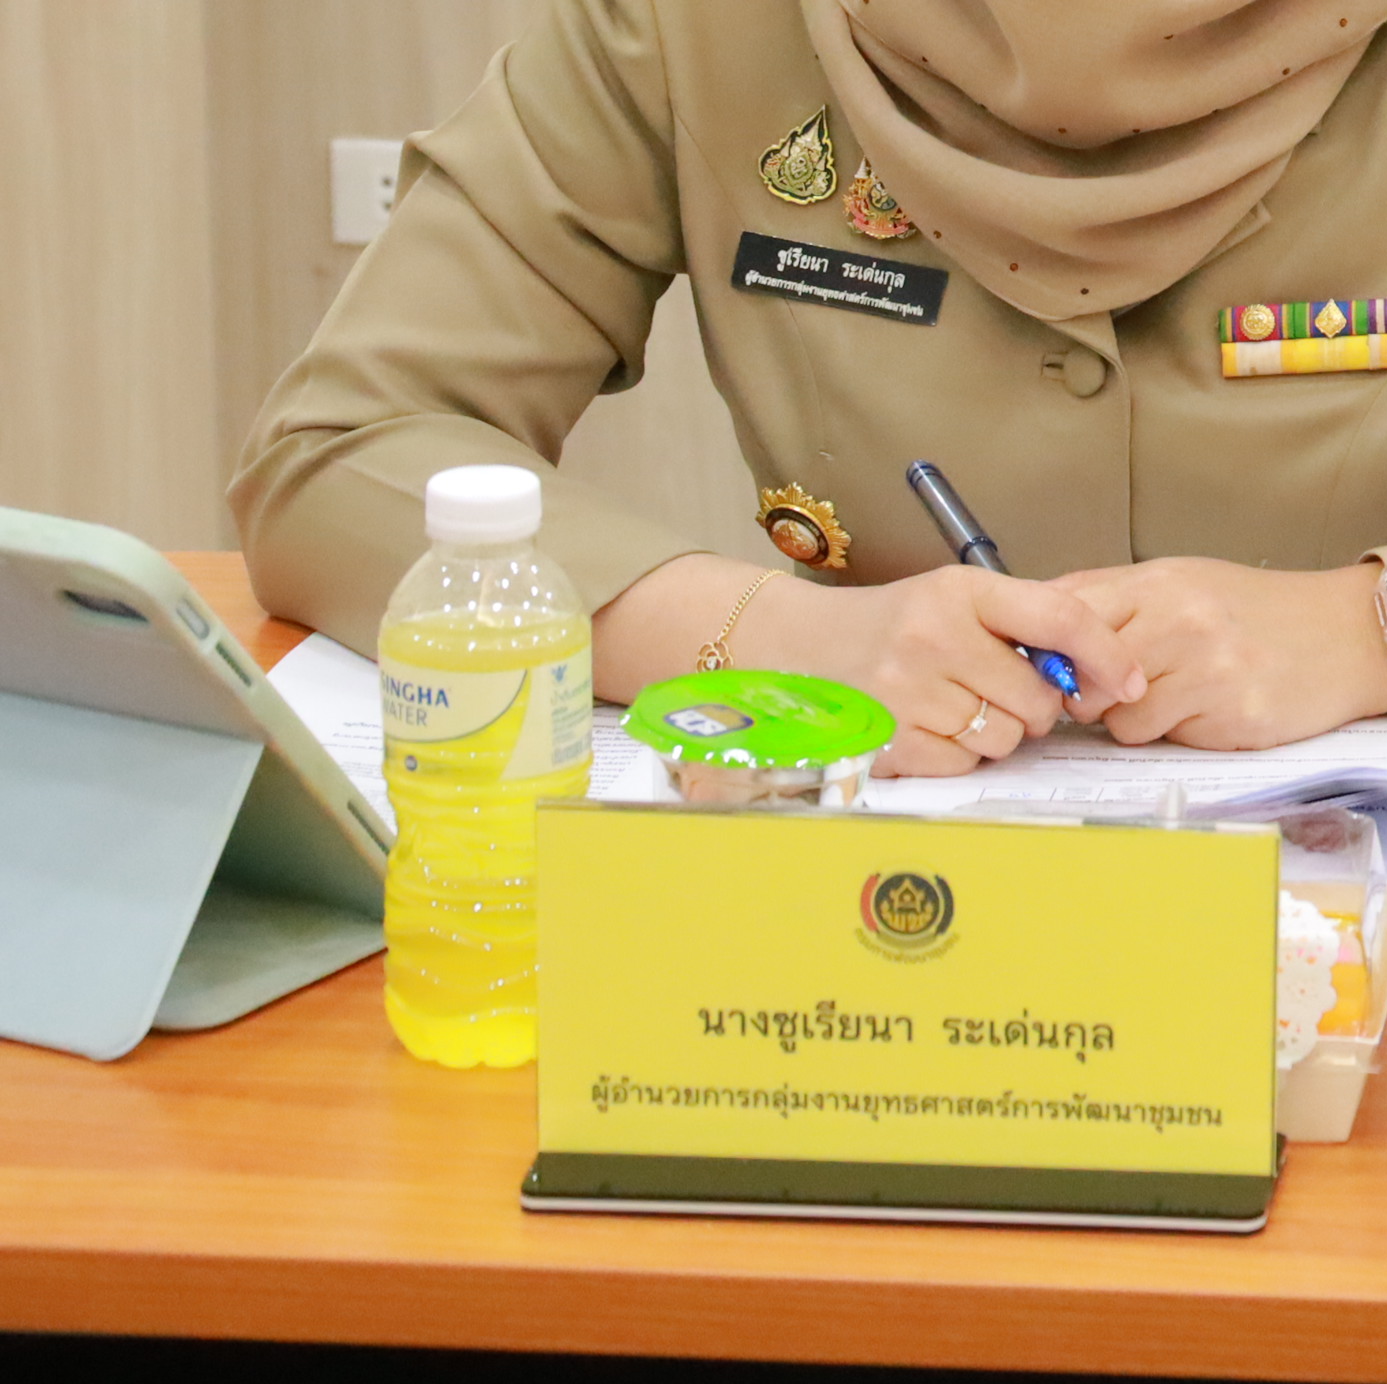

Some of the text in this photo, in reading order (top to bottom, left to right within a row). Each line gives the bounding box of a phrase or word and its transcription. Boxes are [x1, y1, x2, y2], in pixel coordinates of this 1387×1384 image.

[841, 261, 906, 294] ระเด่นกุล
[942, 1008, 1115, 1064] ระเด่นกุล
[591, 1075, 1223, 1133] ผู้อำนวยการกลุ่มงานยุทธศาสตร์การพัฒนาชุมชน
